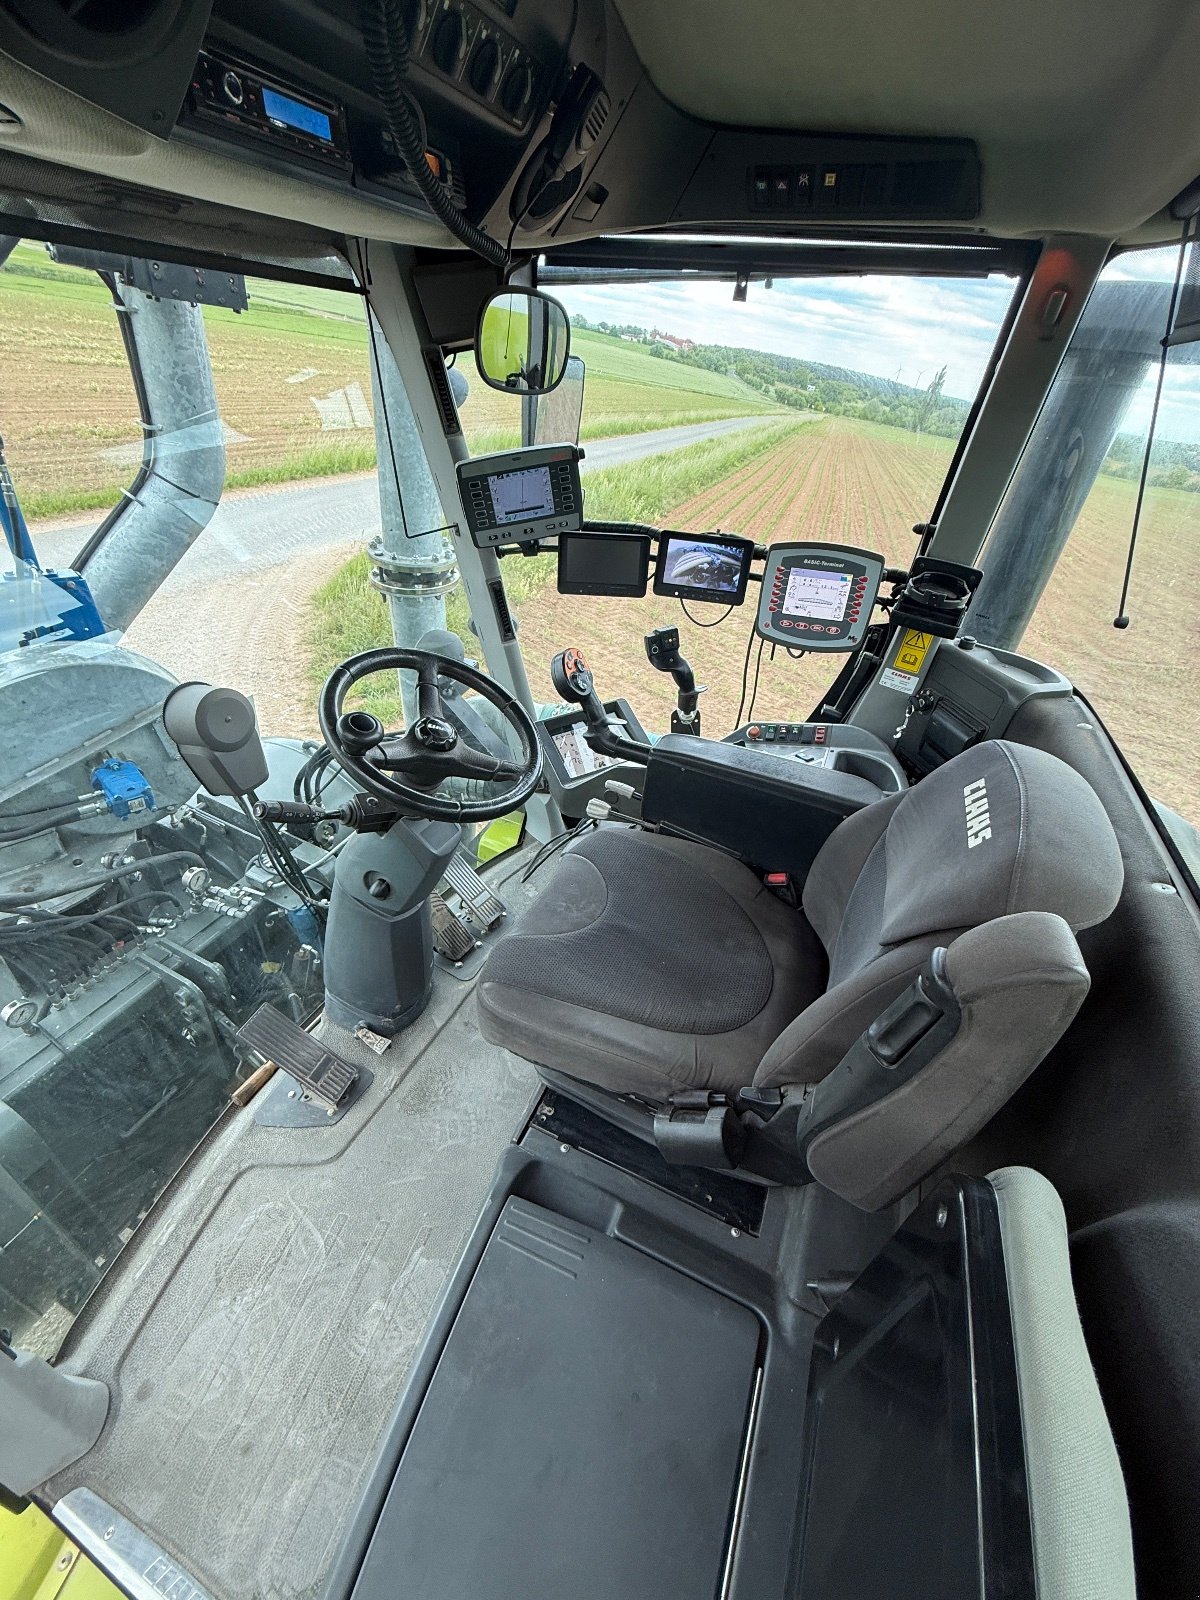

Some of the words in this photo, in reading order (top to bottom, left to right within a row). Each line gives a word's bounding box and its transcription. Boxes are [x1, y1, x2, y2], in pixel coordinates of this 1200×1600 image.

[803, 558, 845, 568] BASIC-Terminal
[891, 671, 912, 680] CLAAS
[963, 777, 993, 849] CLAAS
